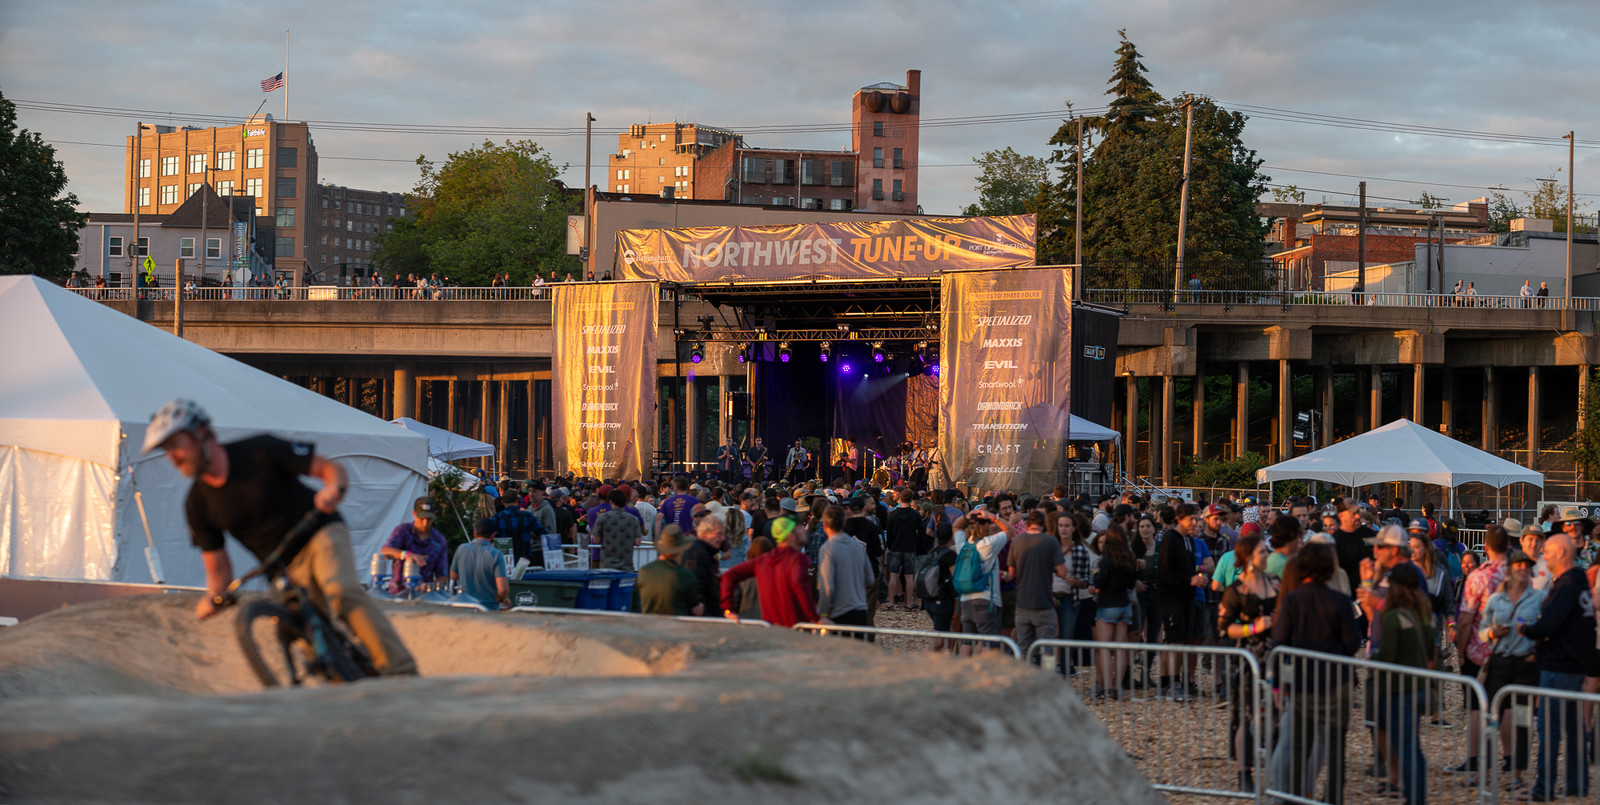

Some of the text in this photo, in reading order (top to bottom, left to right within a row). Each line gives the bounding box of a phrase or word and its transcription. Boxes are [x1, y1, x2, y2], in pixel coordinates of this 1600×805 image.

[683, 235, 962, 268] NORTHWEST TUNE-UP
[976, 315, 1032, 327] SPECIALIZED
[581, 324, 627, 335] SPECIALIZED
[983, 338, 1023, 348] MAXXIS
[586, 345, 620, 354] MAXXIS
[984, 360, 1018, 369] EVIL
[588, 365, 616, 374] EVIL
[582, 383, 614, 391] Smartwool
[978, 380, 1016, 389] Smartwool
[976, 401, 1023, 411] DIAMONDBACK
[581, 441, 617, 450] CRAFT
[977, 443, 1021, 454] CRAFT
